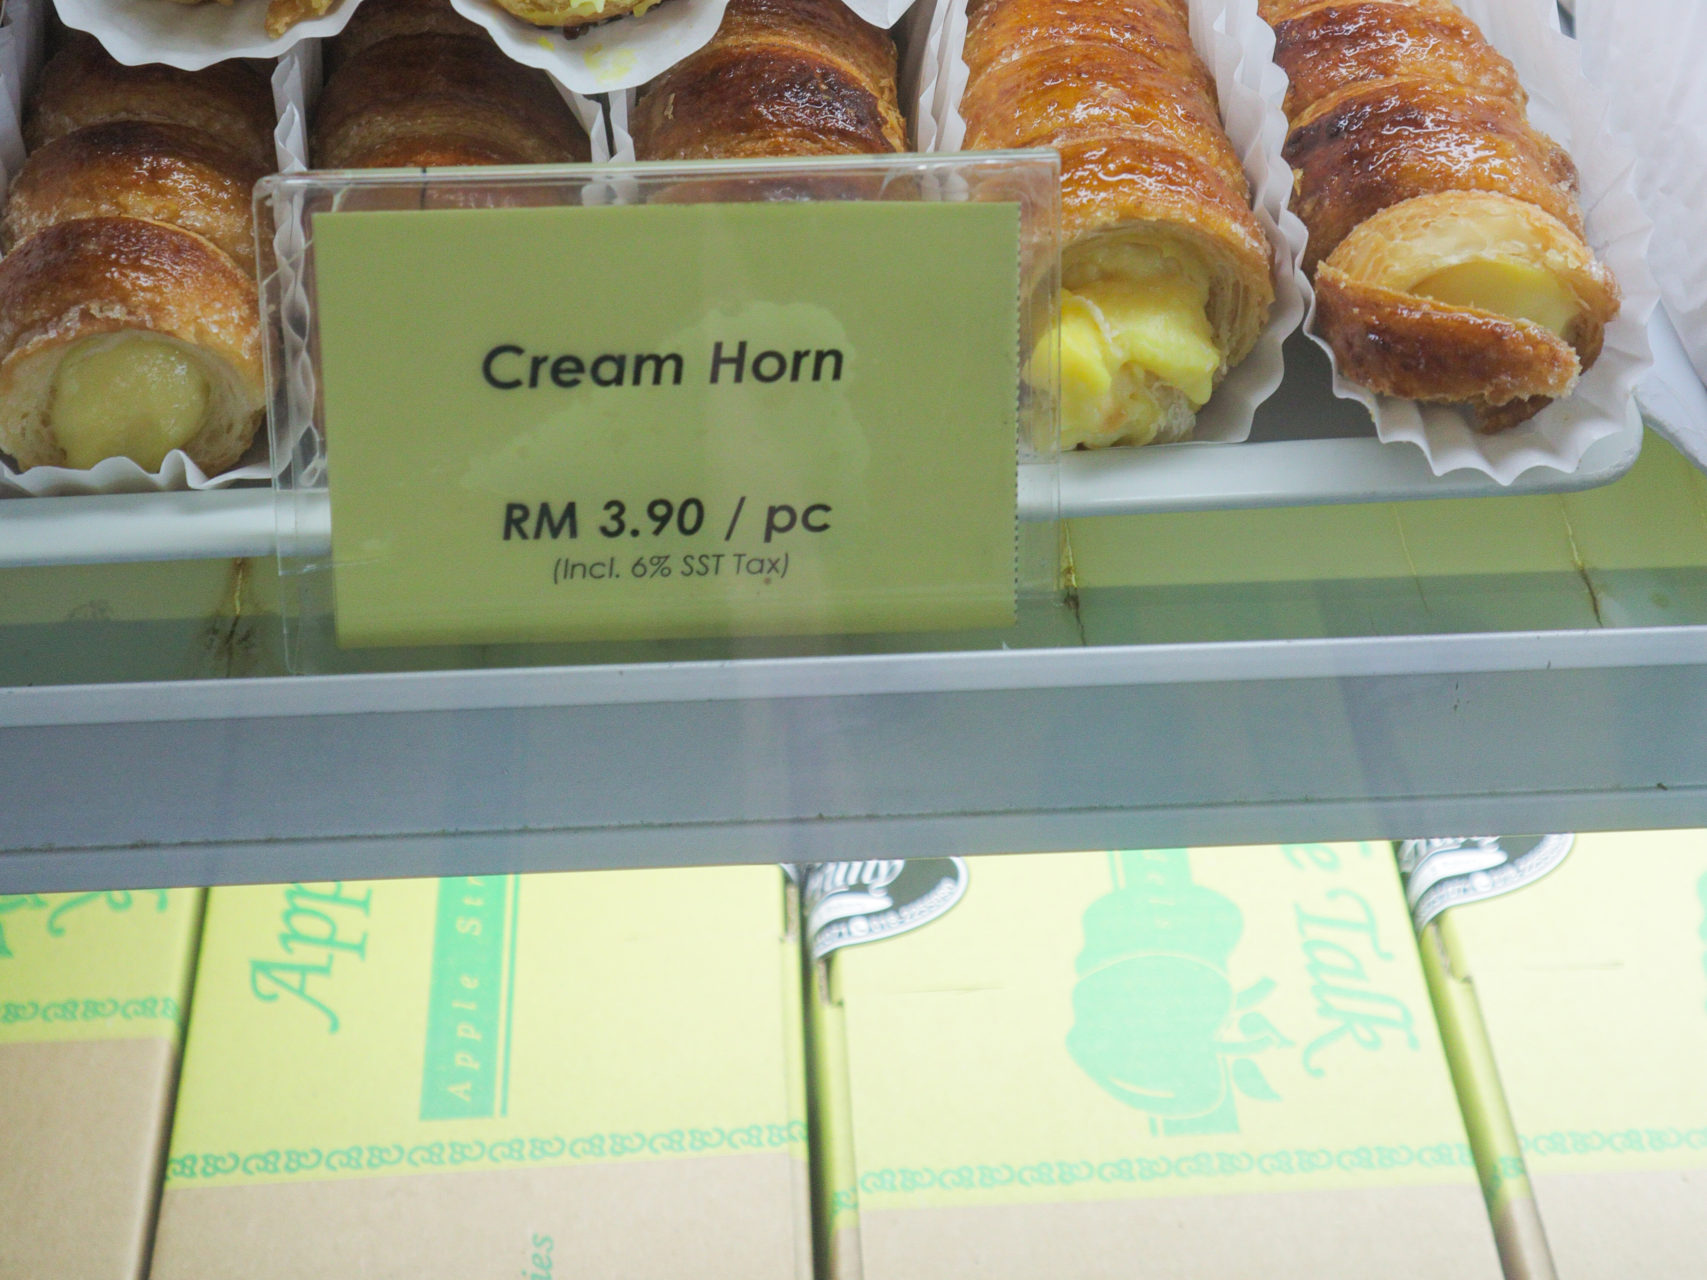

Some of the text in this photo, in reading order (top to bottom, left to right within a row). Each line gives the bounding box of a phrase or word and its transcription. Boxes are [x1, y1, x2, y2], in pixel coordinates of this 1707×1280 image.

[481, 340, 844, 390] Cream Horn
[502, 496, 833, 543] RM 3.90 / pc
[552, 552, 789, 584] (Incl. 6% SST Tax)
[1293, 887, 1421, 1079] Talk
[447, 972, 482, 1102] Apple
